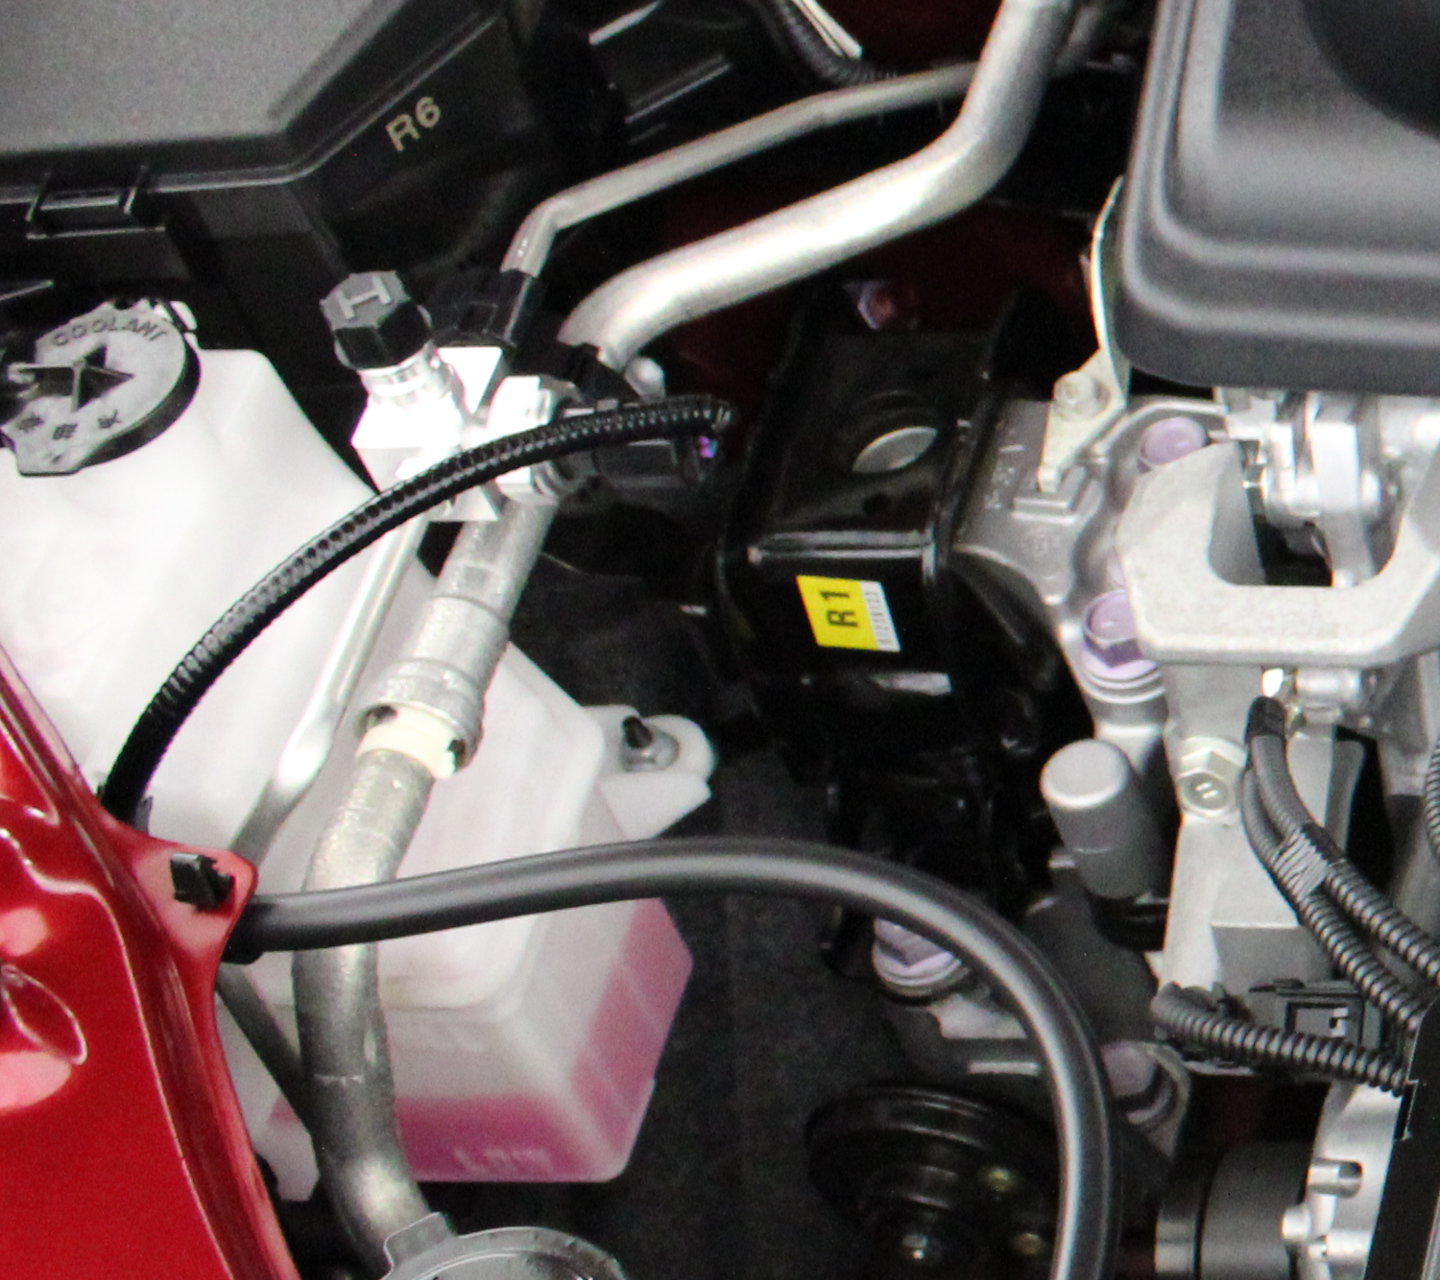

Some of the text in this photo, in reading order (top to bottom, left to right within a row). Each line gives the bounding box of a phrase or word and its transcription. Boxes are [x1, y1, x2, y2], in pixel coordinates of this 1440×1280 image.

[384, 96, 441, 153] R6
[52, 316, 169, 347] COOLANT
[820, 590, 858, 628] R1
